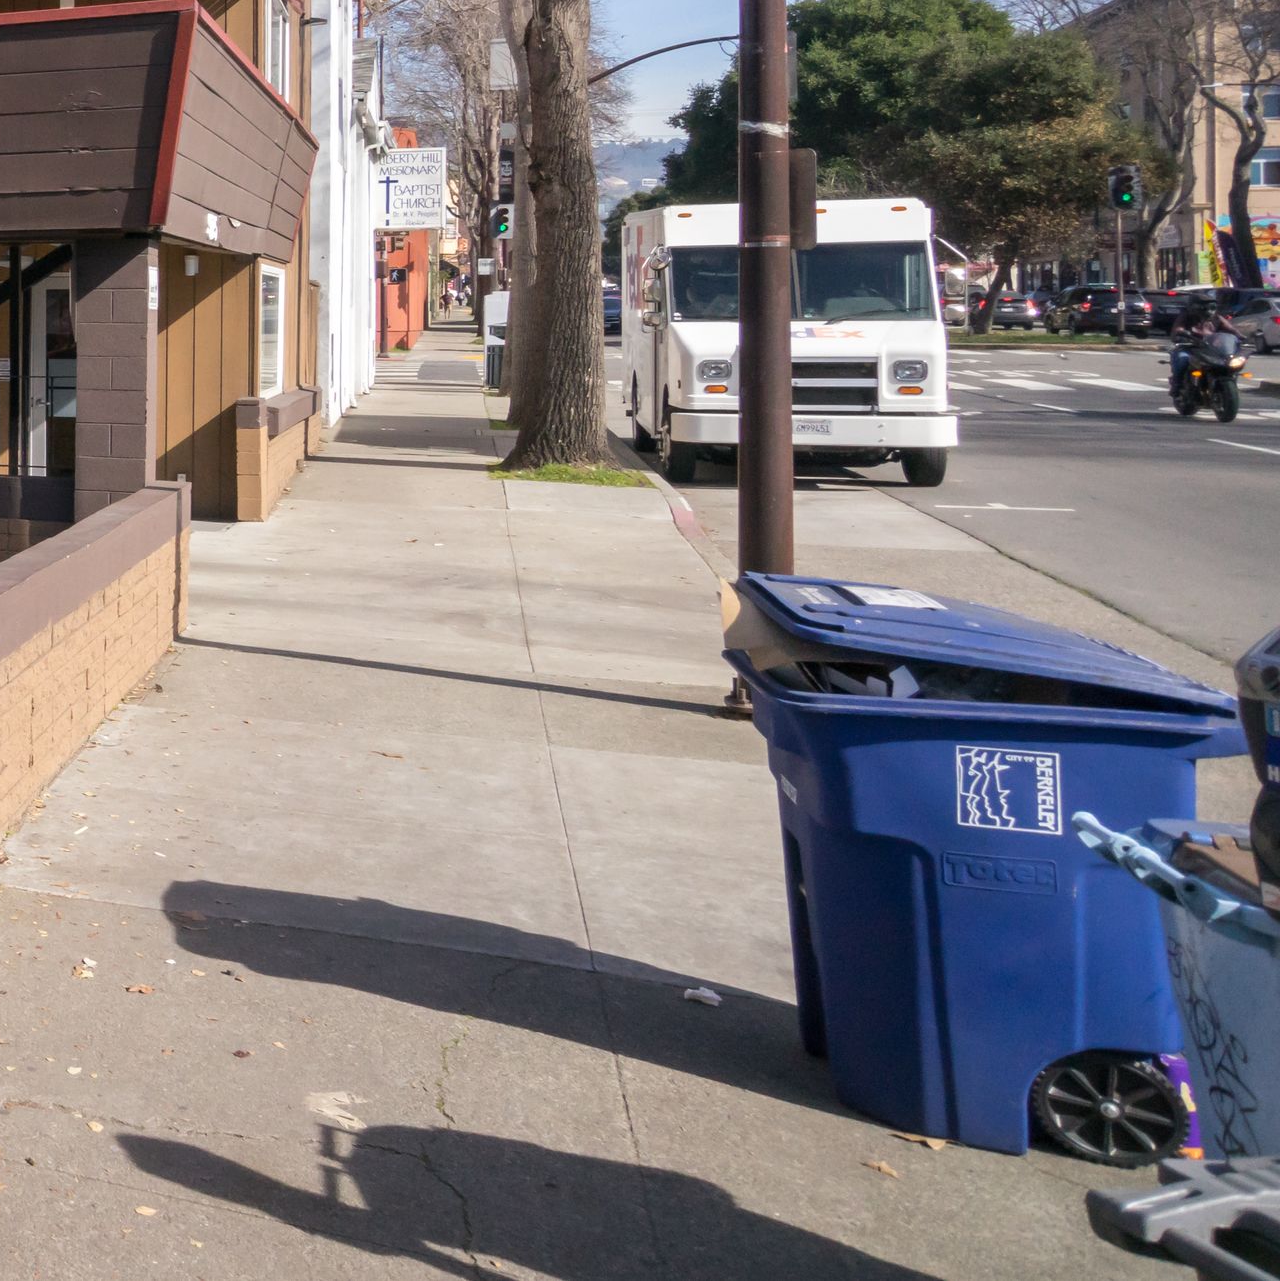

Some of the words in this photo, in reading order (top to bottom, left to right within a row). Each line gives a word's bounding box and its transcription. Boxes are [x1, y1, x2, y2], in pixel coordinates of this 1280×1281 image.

[421, 152, 440, 163] HILL
[379, 165, 441, 176] MISSIONARY
[393, 184, 441, 196] BAPTIST
[392, 197, 441, 209] CHURCH
[1005, 754, 1023, 763] CITY
[1036, 756, 1056, 831] BERKELEY
